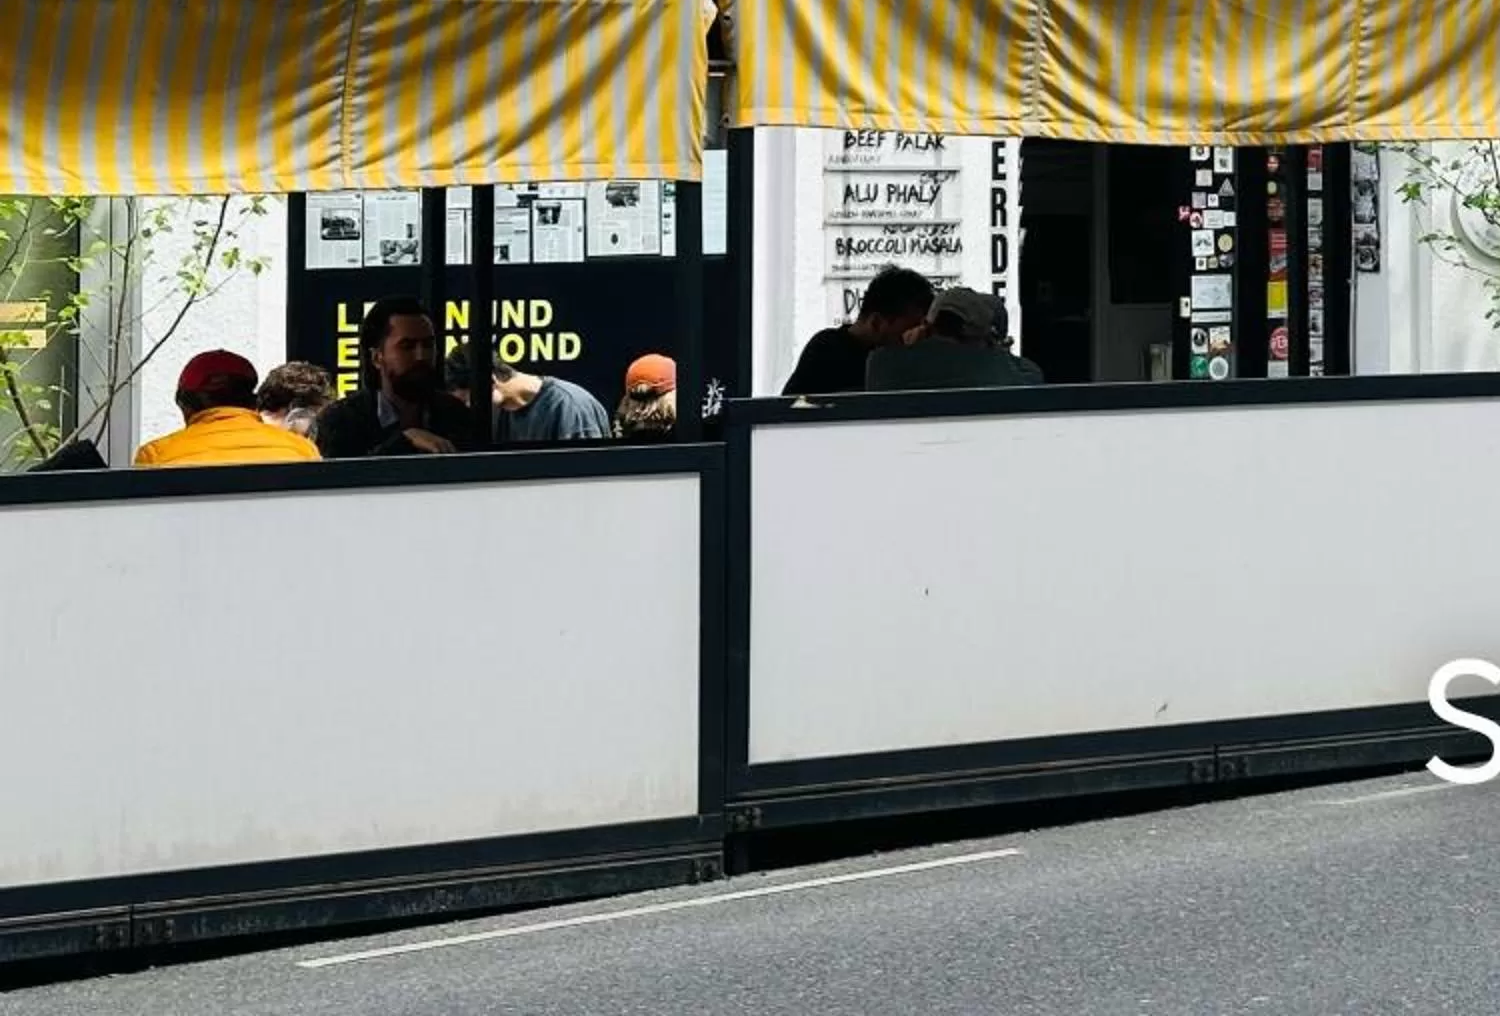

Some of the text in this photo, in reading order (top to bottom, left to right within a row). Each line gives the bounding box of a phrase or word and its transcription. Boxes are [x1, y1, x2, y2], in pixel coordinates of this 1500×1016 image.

[844, 130, 945, 151] BEEF PALAK
[843, 183, 941, 206] ALU PHALY
[835, 236, 963, 256] BROCCOLI MASALA
